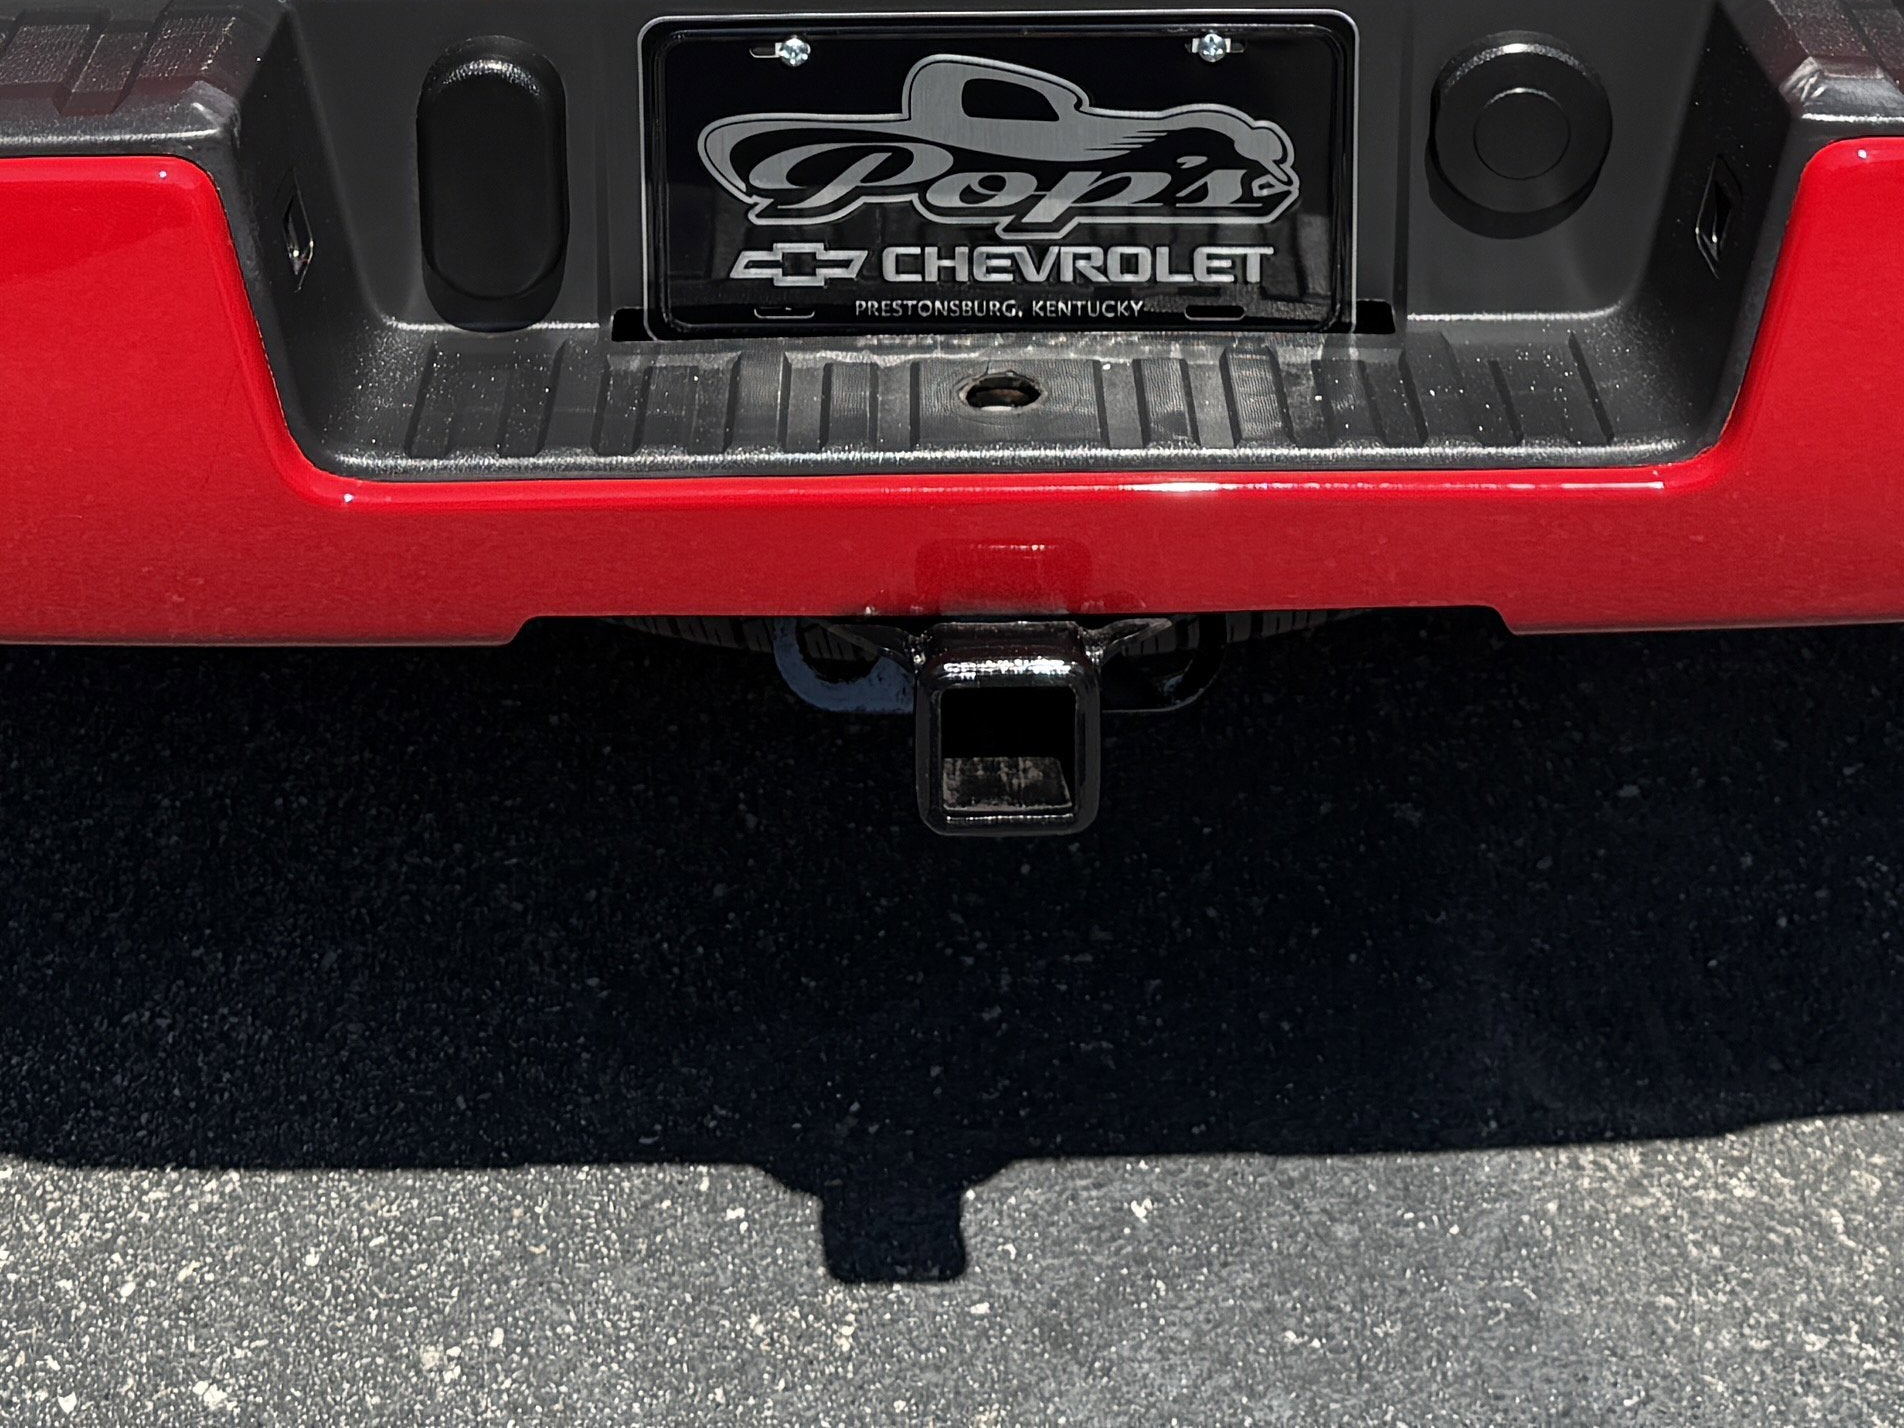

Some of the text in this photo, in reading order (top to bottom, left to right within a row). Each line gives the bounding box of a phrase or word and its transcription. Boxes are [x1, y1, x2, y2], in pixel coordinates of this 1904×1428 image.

[748, 142, 1264, 224] Pop's
[881, 245, 1274, 284] CHEVROLET
[854, 299, 1144, 319] PRESTONSBURG, KENTUCKY
